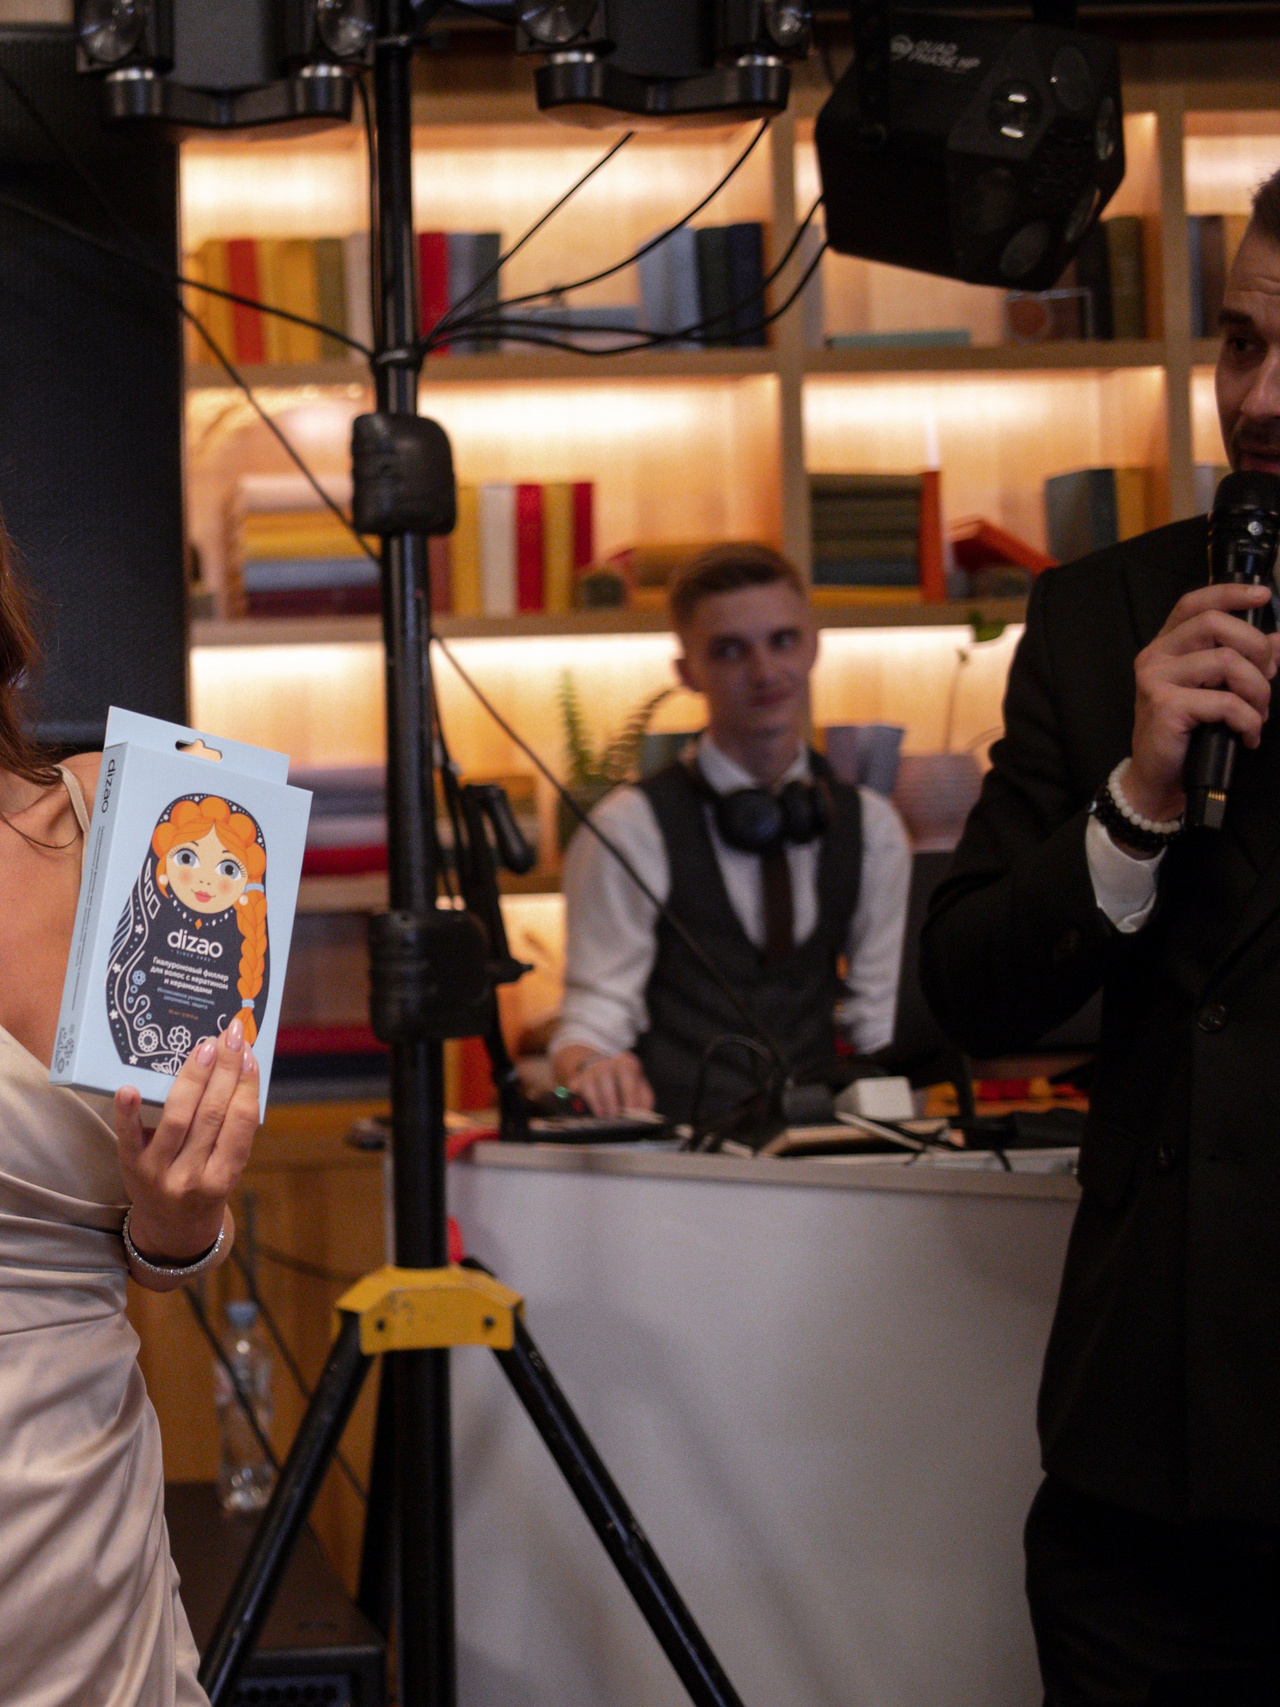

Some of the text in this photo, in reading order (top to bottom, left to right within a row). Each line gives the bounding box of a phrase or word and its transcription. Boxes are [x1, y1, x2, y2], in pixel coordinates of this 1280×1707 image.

[101, 759, 116, 813] dizao
[167, 928, 223, 958] dizao
[150, 966, 164, 975] для
[164, 969, 185, 980] волос
[191, 976, 229, 990] кератином
[152, 956, 229, 983] Гиалуроновый филлер
[170, 979, 213, 995] керамидами
